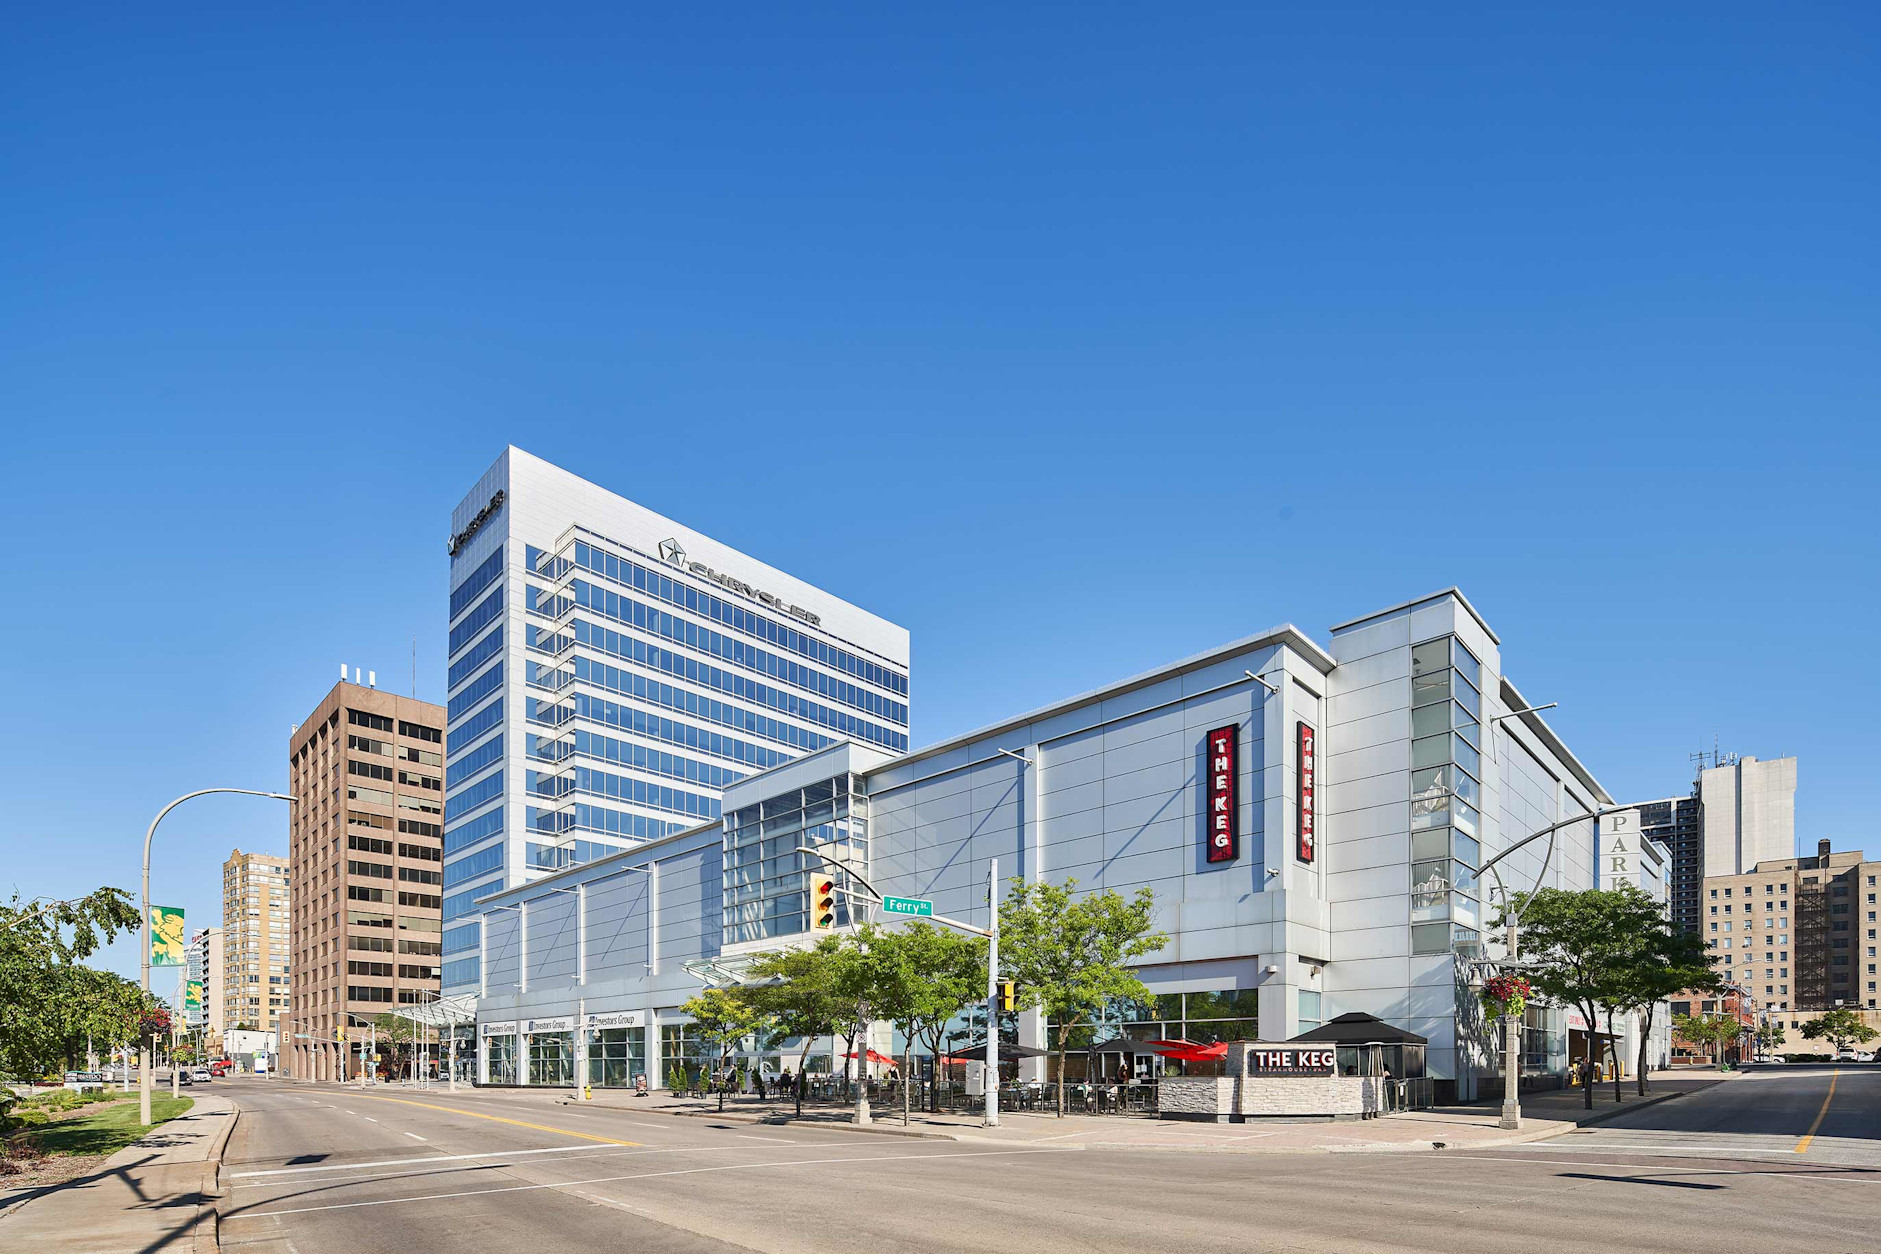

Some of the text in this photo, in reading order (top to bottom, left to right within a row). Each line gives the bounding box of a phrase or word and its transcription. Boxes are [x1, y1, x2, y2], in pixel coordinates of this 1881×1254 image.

[689, 561, 822, 627] CHRYSLER
[1215, 738, 1229, 848] THE KEG
[1304, 737, 1313, 847] THE KEG
[890, 899, 919, 915] Ferry
[534, 1020, 566, 1030] Investors Group
[596, 1014, 635, 1026] Investors Group
[487, 1024, 515, 1033] Investors Group
[1256, 1051, 1334, 1067] THE KEG
